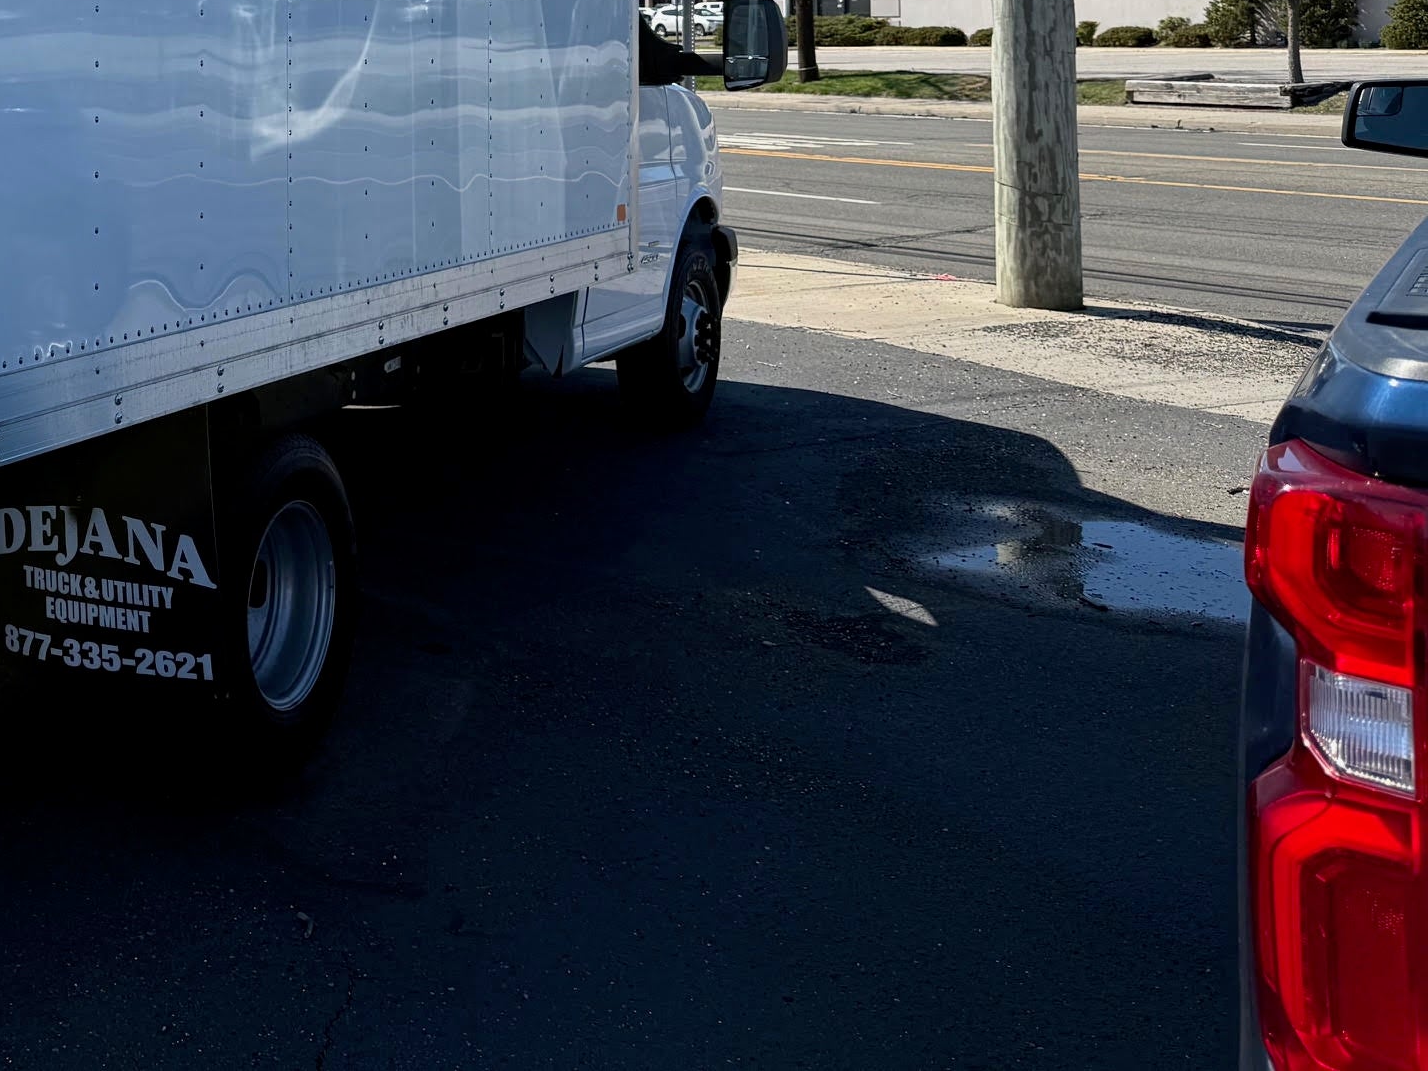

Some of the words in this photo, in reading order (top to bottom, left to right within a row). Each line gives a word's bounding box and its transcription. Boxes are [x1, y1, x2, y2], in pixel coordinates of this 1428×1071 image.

[23, 564, 82, 597] TRUCK
[84, 576, 100, 600] &
[101, 578, 174, 610] UTILITY
[45, 596, 151, 633] EQUIPMENT
[4, 623, 214, 681] 877-335-2621
